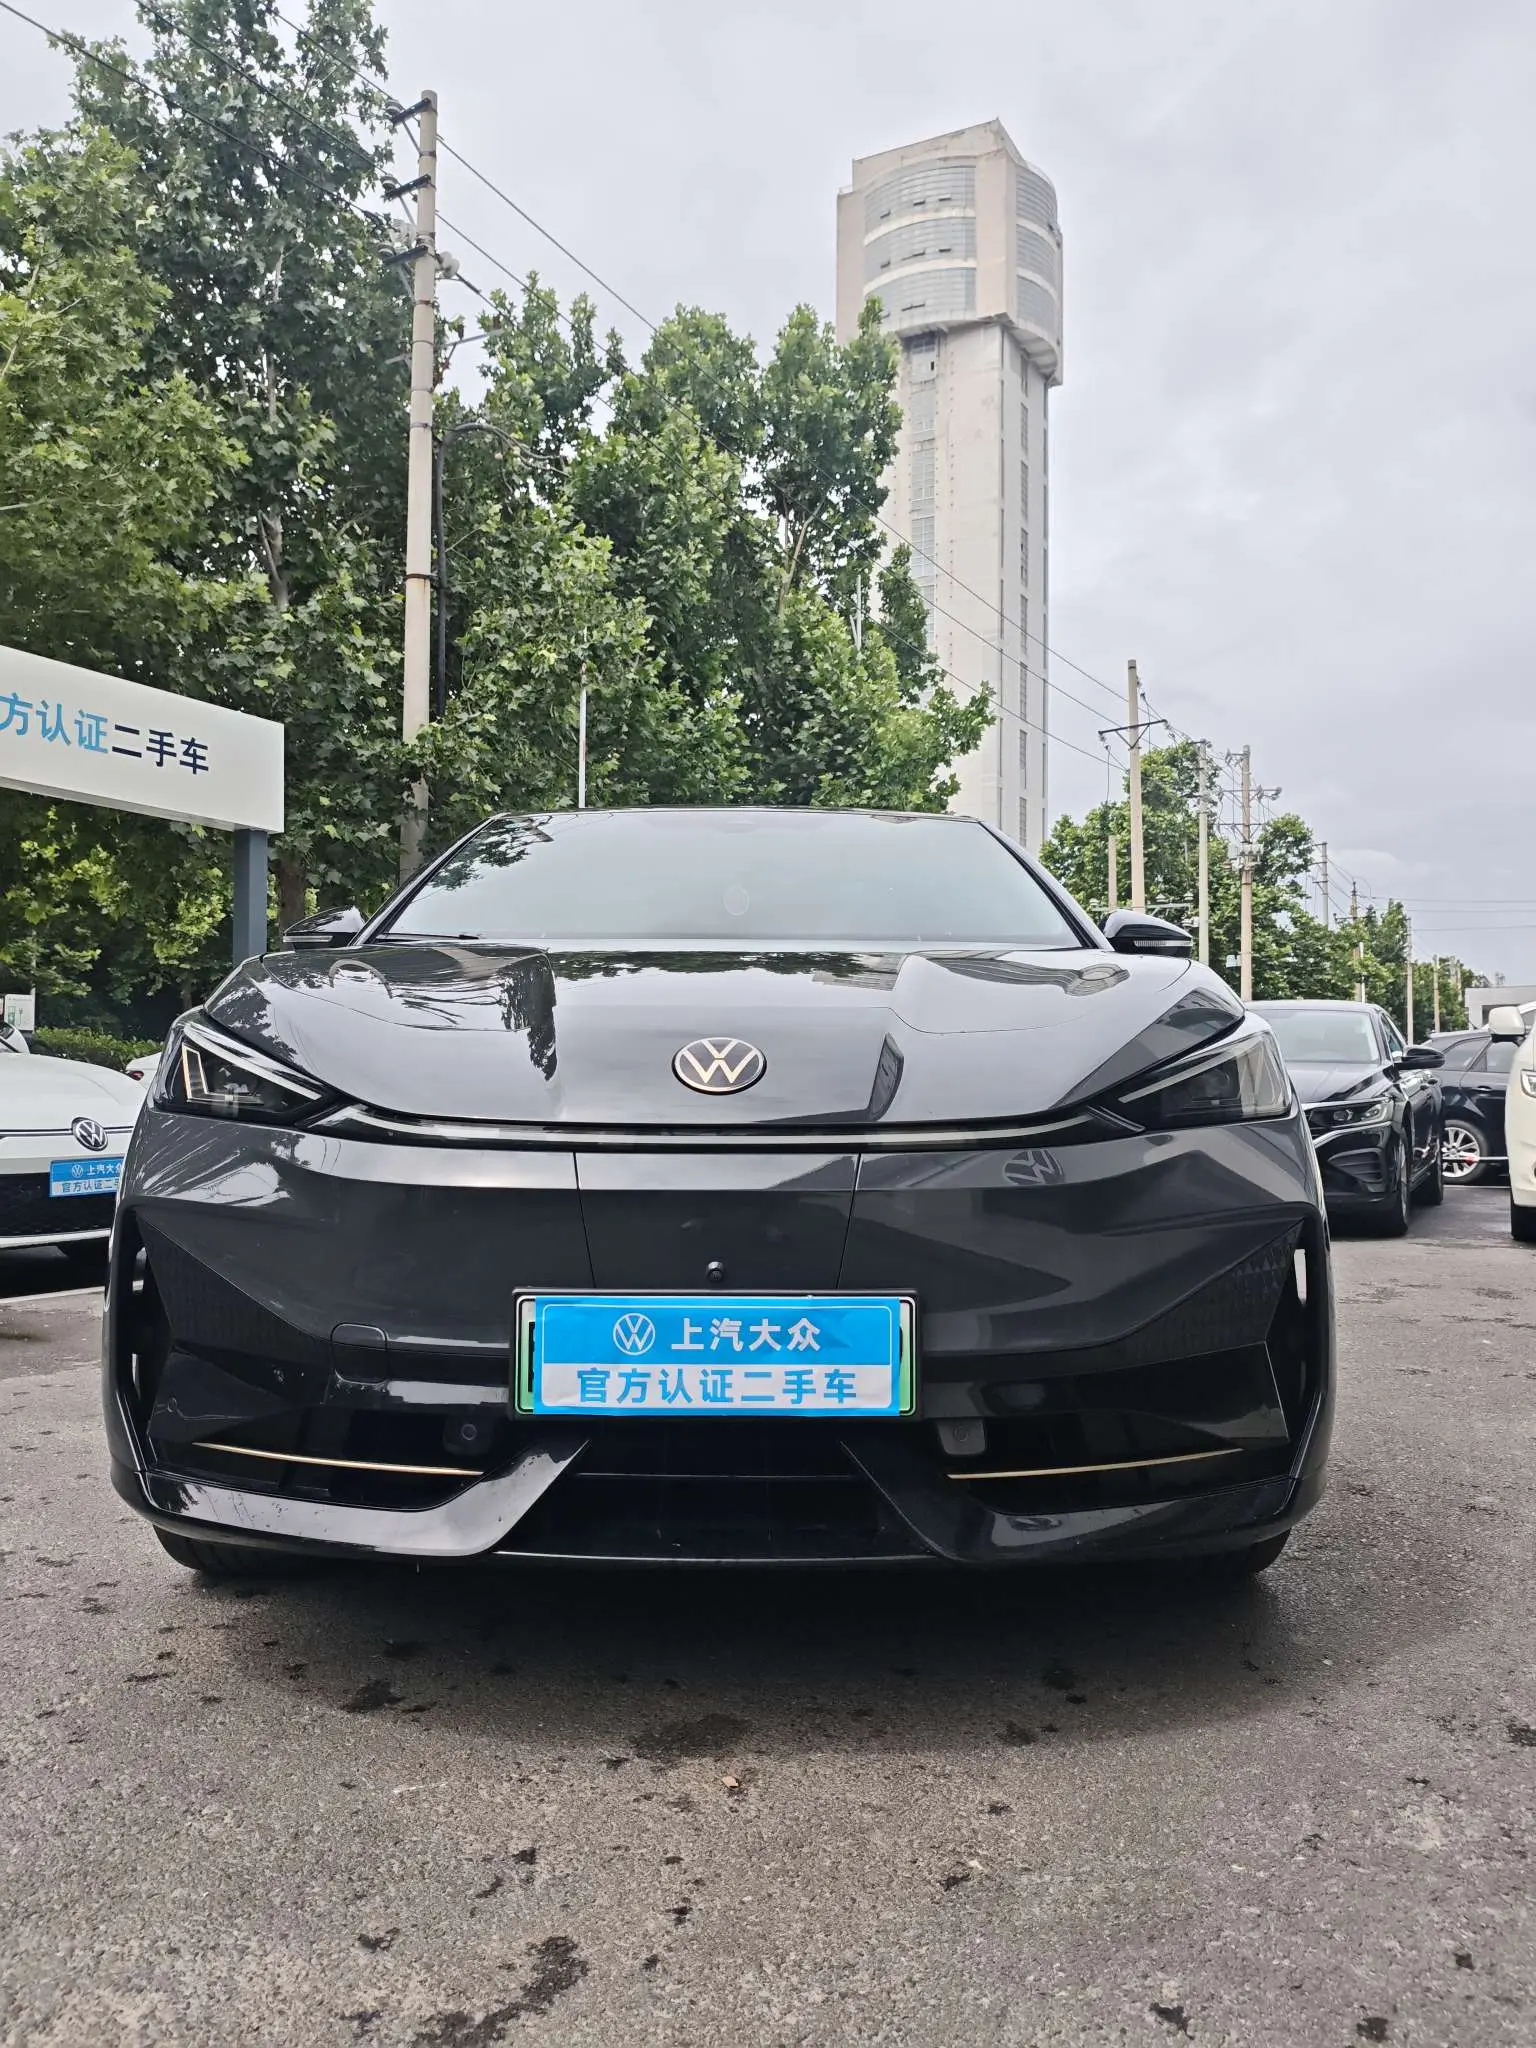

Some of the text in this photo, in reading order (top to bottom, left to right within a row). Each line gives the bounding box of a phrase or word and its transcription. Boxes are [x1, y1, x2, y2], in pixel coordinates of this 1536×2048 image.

[671, 1317, 821, 1352] 上汽大众
[577, 1367, 857, 1404] 官方认证二手车
